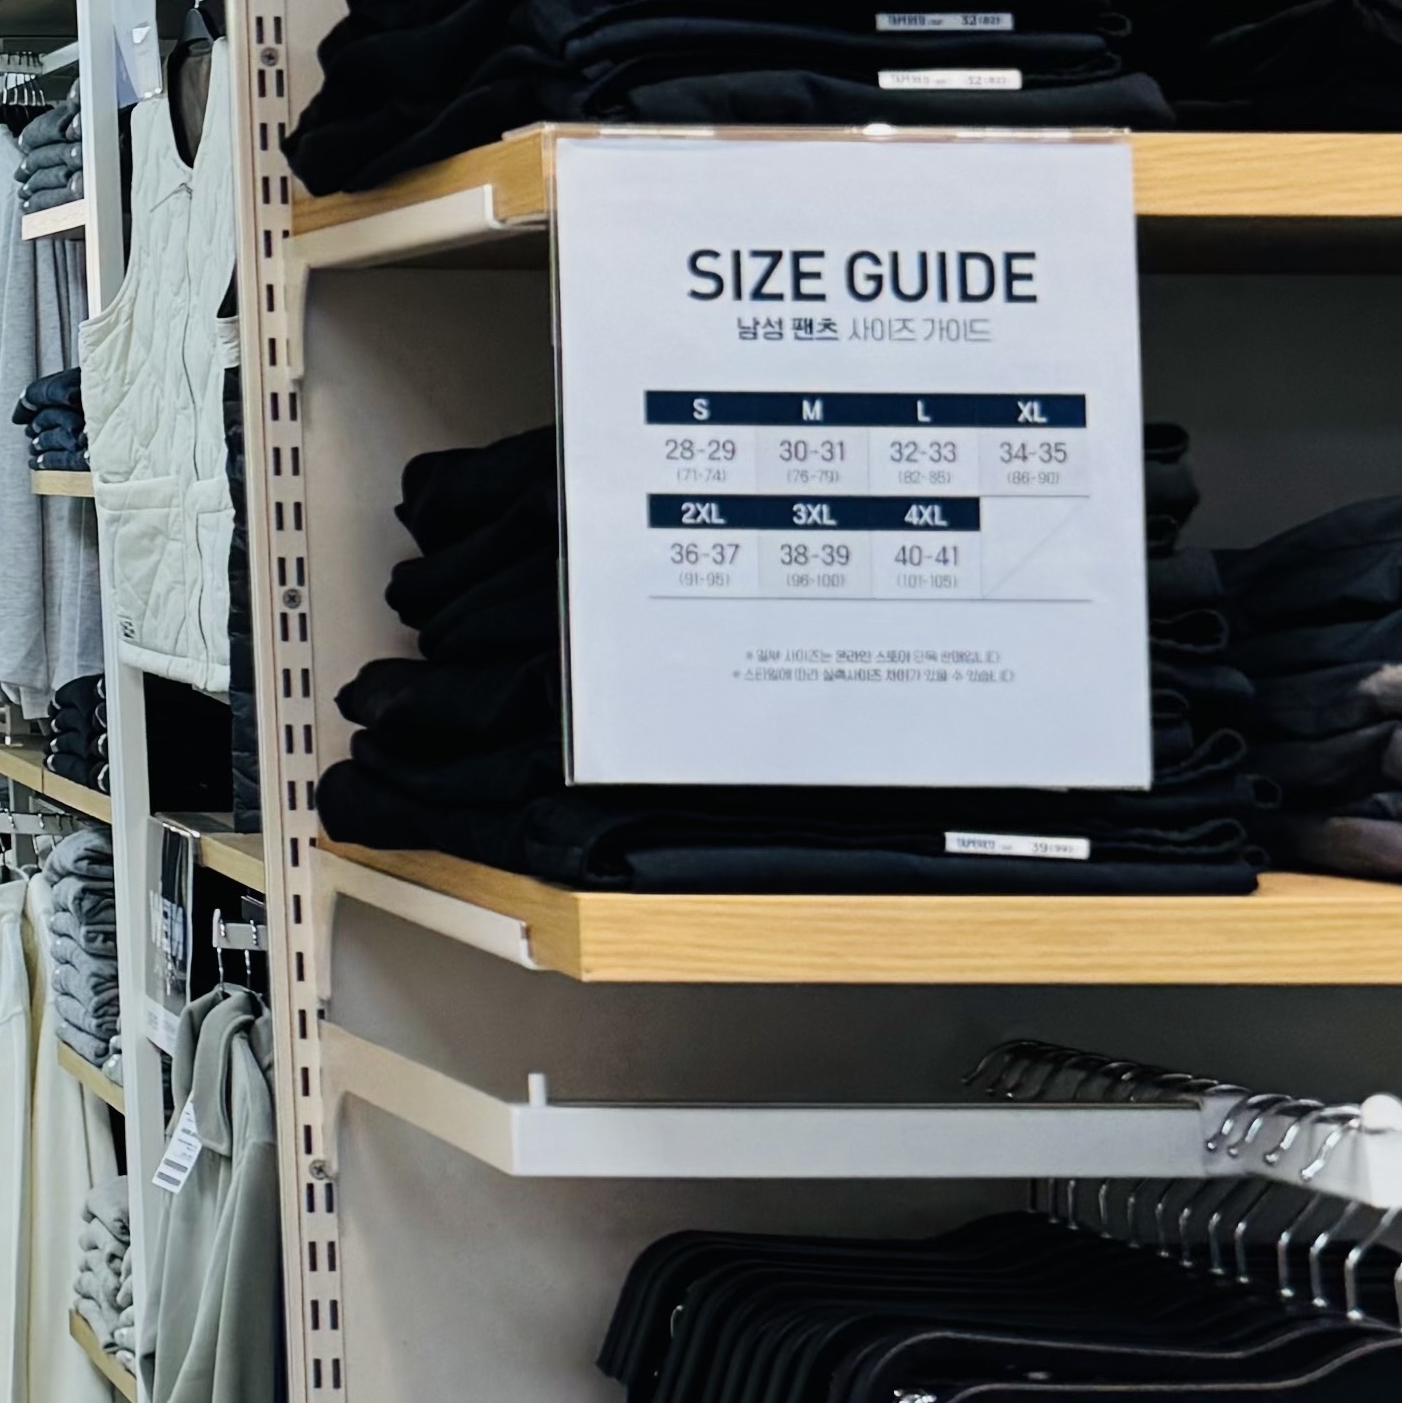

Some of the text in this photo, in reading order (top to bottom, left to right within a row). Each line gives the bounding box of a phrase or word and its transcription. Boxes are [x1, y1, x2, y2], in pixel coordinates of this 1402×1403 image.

[686, 248, 1038, 304] SIZE GUIDE
[736, 317, 992, 344] 남성 팬츠 사이즈 가이드
[692, 399, 1048, 423] S M L XL
[664, 439, 1067, 465] 28-29 30-31 32-33 34-35
[680, 503, 949, 527] 2XL 3XL 4XL
[669, 543, 960, 568] 36-37 38-39 40-41
